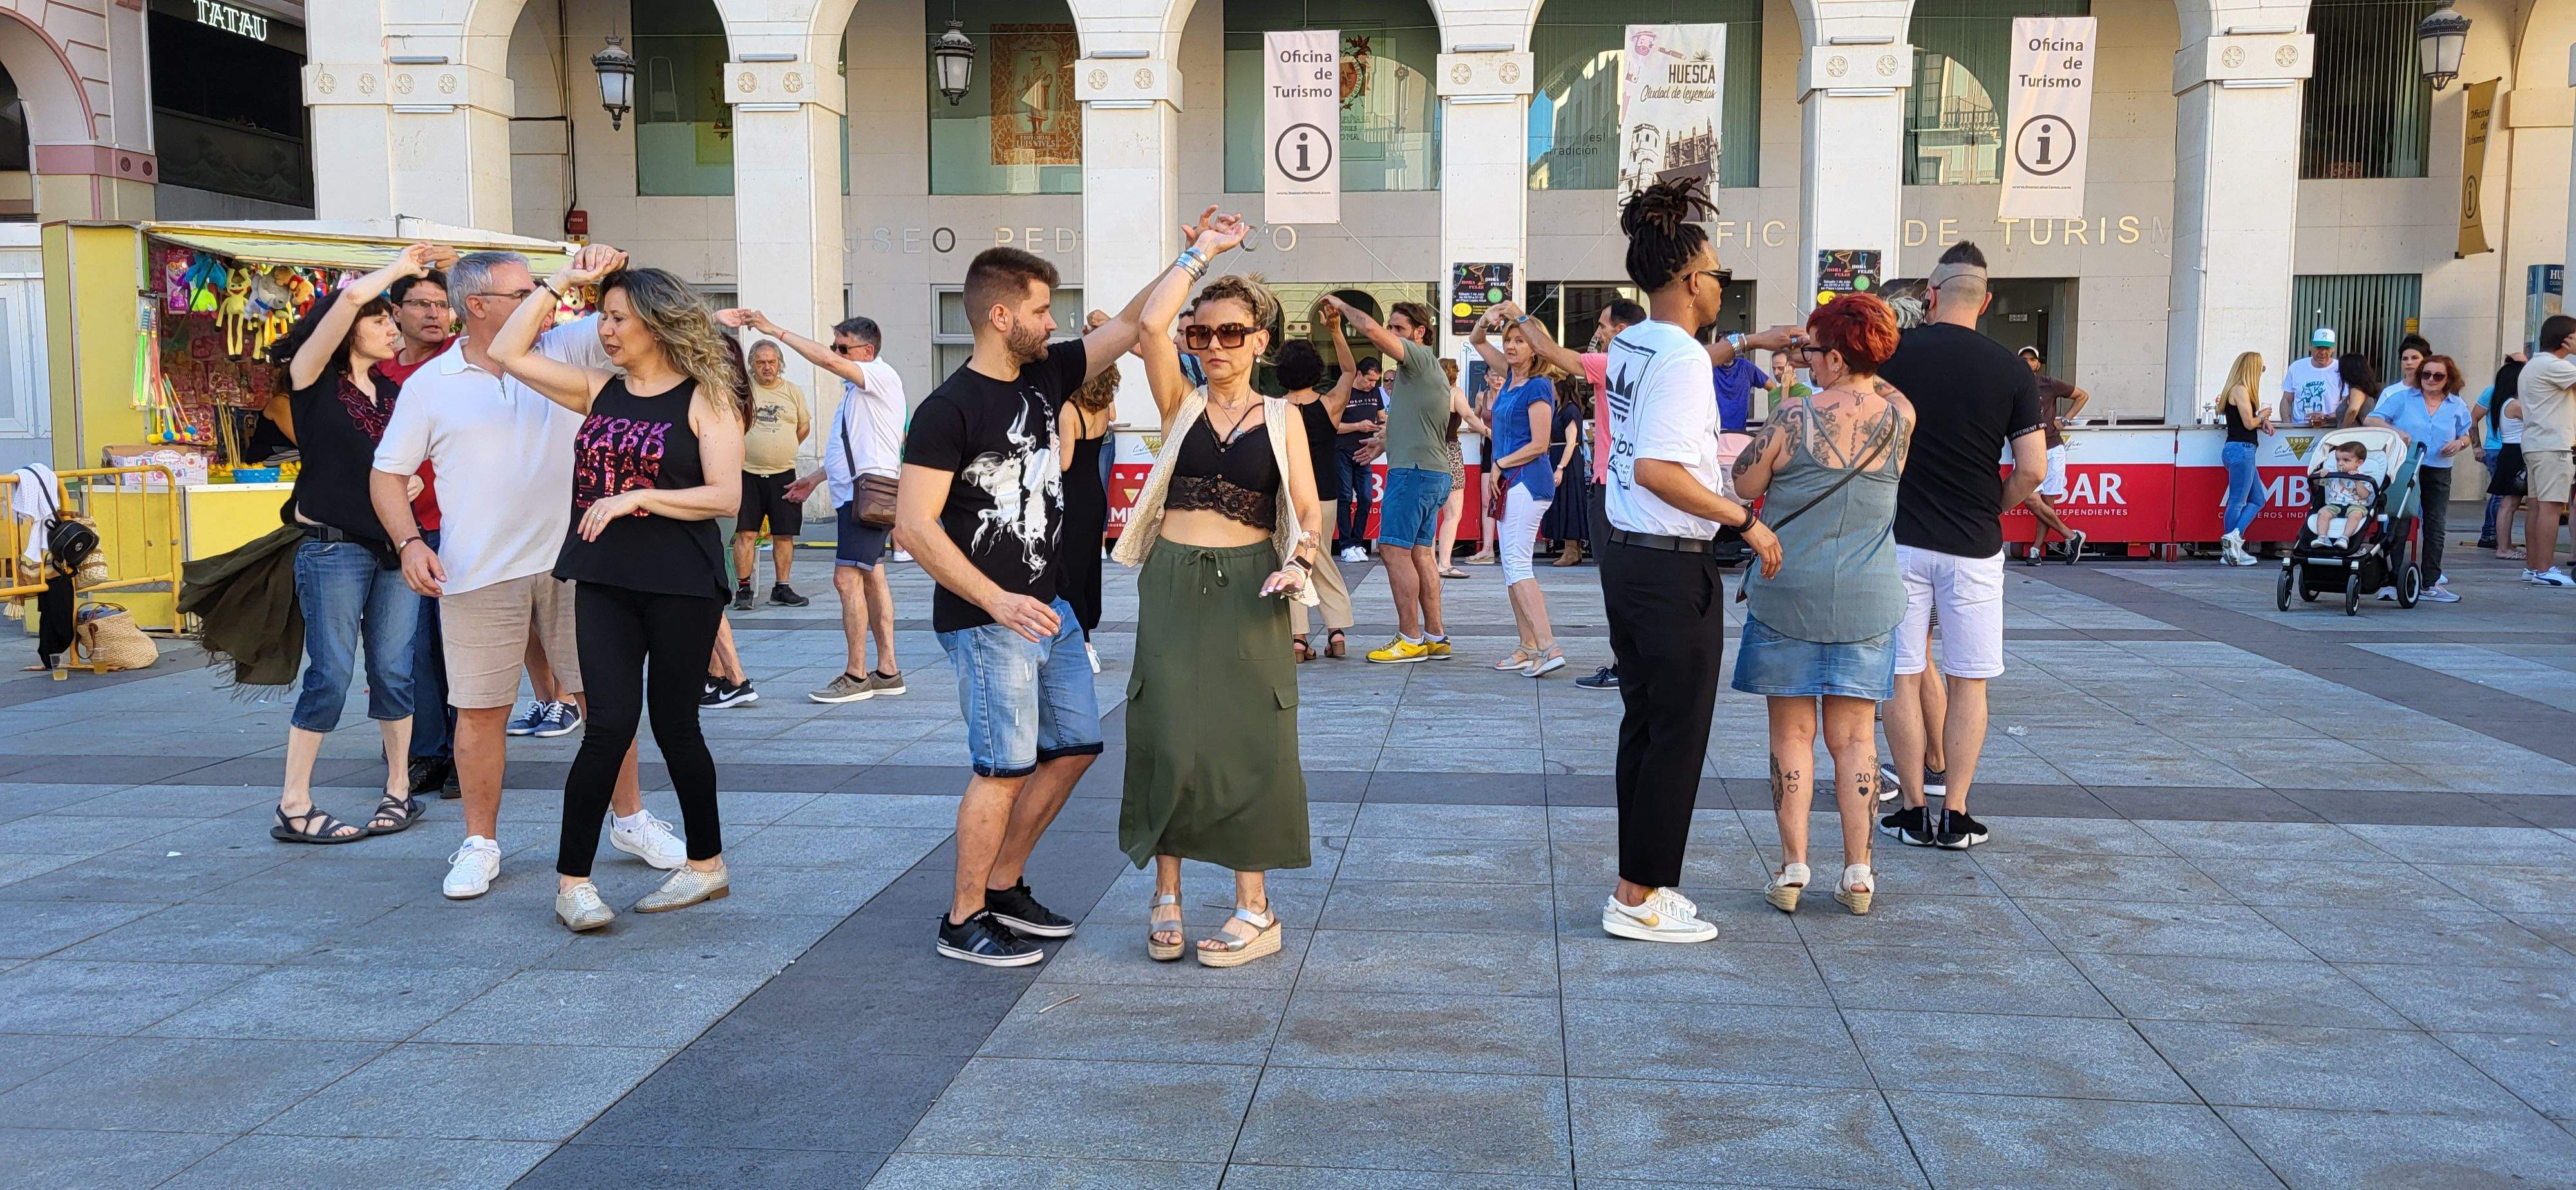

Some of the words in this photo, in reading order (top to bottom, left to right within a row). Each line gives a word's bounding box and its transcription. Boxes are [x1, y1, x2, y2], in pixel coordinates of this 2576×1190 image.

[193, 0, 267, 41] TATAU
[2029, 37, 2083, 52] Oficina
[1280, 50, 1332, 63] Oficina
[2063, 56, 2083, 70] de
[1314, 67, 1332, 80] de
[1669, 64, 1716, 84] HUESCA
[2018, 74, 2081, 88] Turismo
[1273, 84, 1332, 98] Turismo
[1640, 84, 1671, 102] Ciudad
[1671, 86, 1681, 99] de
[1683, 86, 1717, 104] leyendas
[2470, 108, 2490, 120] Oficina
[2480, 119, 2488, 129] de
[1547, 145, 1598, 155] Tradición
[1904, 219, 1958, 247] DE
[1997, 216, 2173, 246] TURISM
[842, 227, 956, 254] USEO
[1855, 773, 1871, 783] 20
